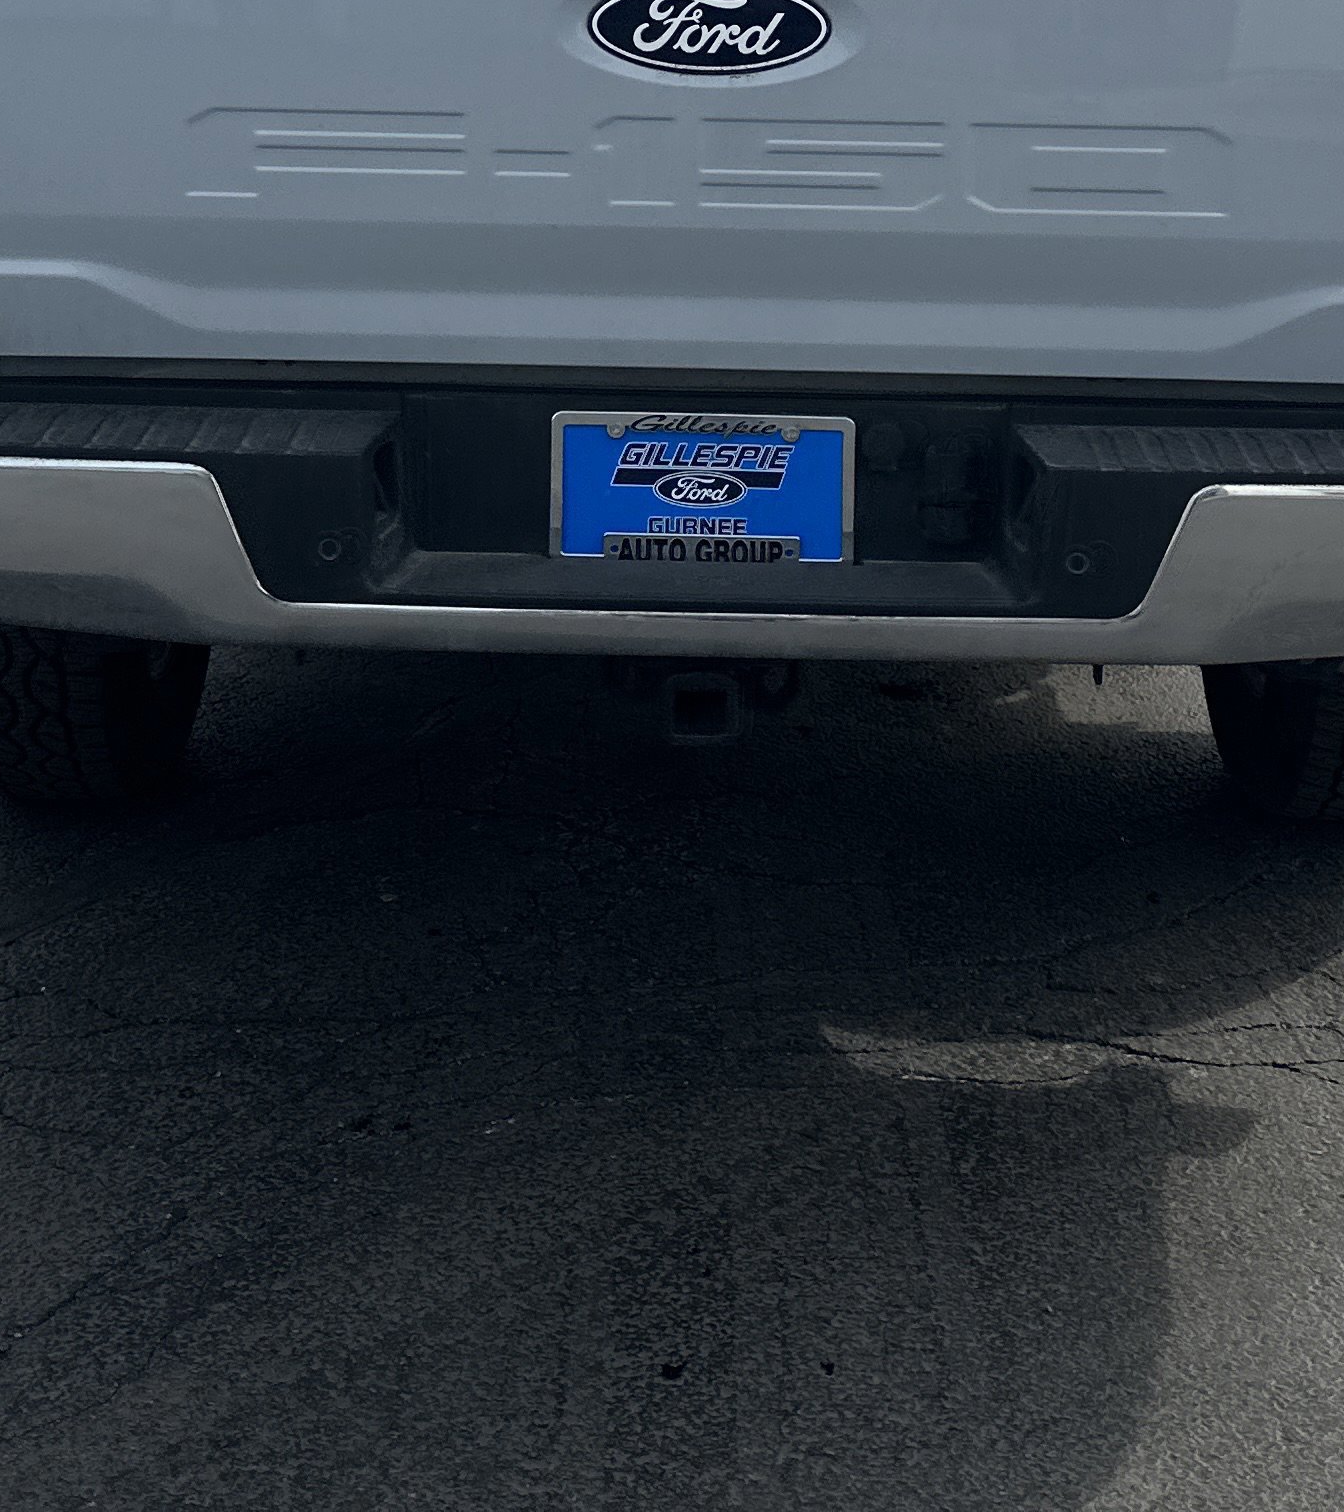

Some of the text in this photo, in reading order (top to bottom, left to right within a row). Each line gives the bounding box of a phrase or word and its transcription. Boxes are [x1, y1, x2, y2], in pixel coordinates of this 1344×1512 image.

[186, 106, 1233, 218] F-150
[630, 414, 778, 439] Gillespie
[618, 442, 795, 470] GILLESPIE
[671, 476, 729, 502] Ford
[647, 516, 748, 536] GURNEE
[617, 538, 784, 563] AUTO GROUP
